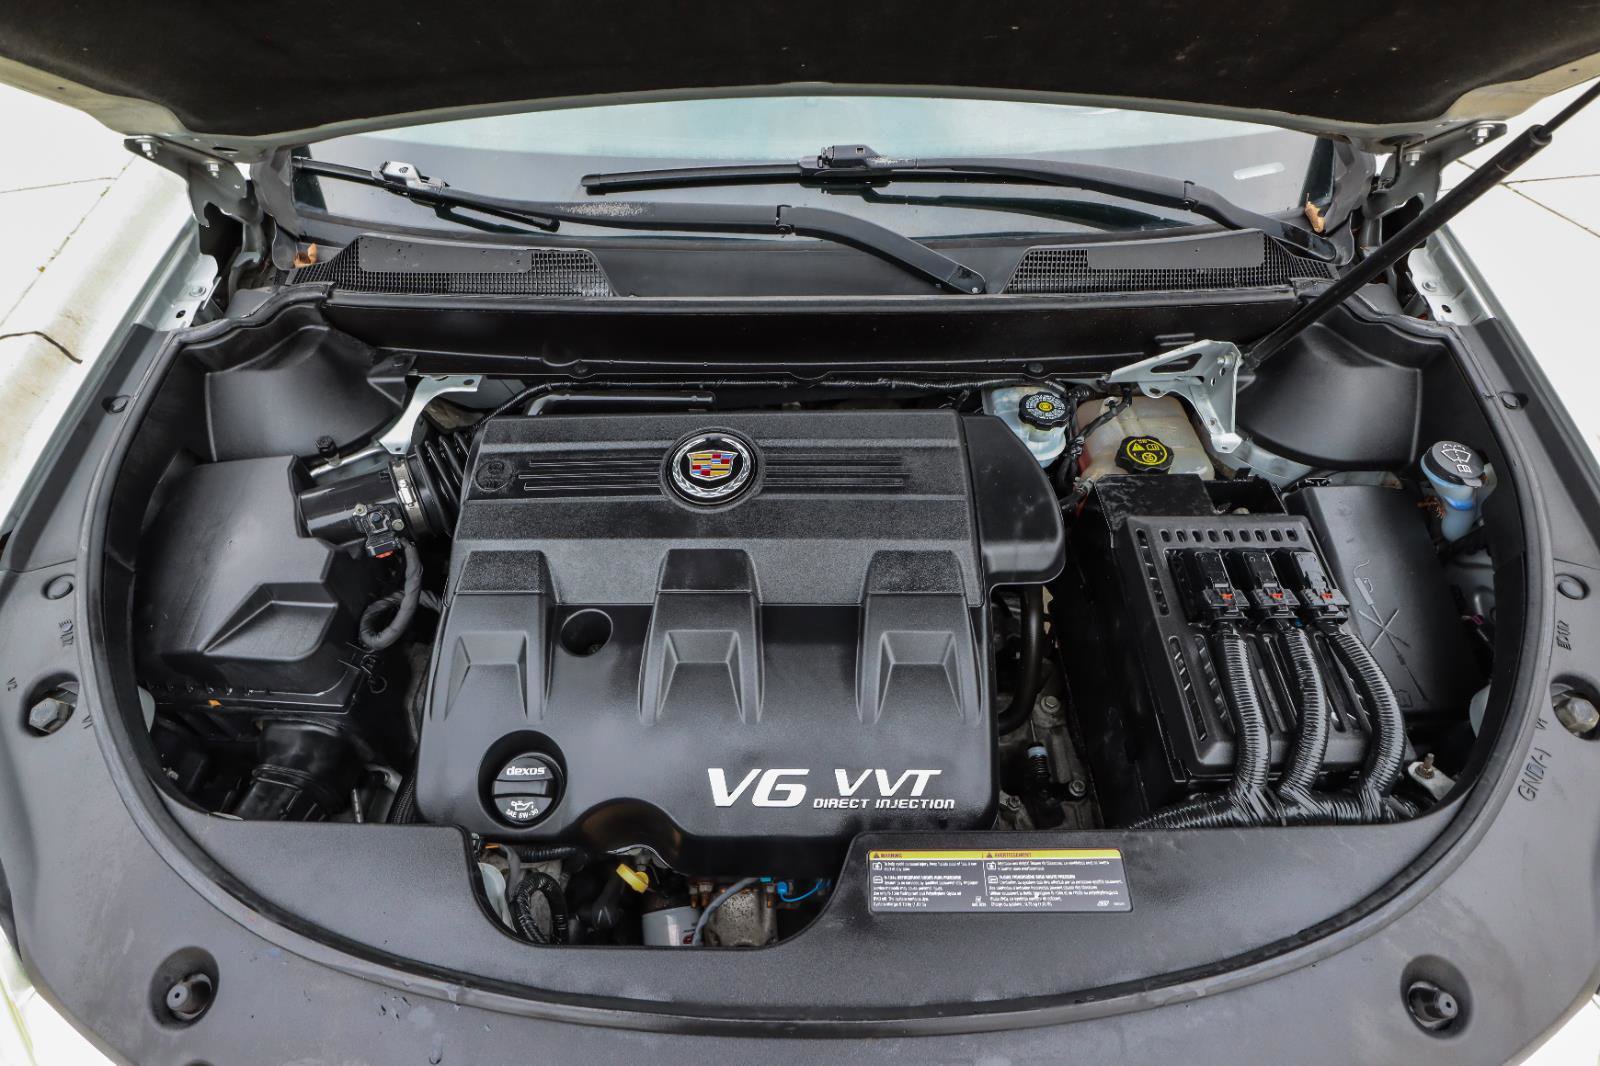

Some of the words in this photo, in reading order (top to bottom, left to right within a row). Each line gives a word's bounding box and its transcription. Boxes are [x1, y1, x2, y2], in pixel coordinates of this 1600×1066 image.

[506, 765, 546, 776] dexos
[707, 768, 810, 807] V6
[834, 768, 943, 797] VVT
[813, 798, 868, 809] DIRECT
[875, 799, 956, 810] INJECTION
